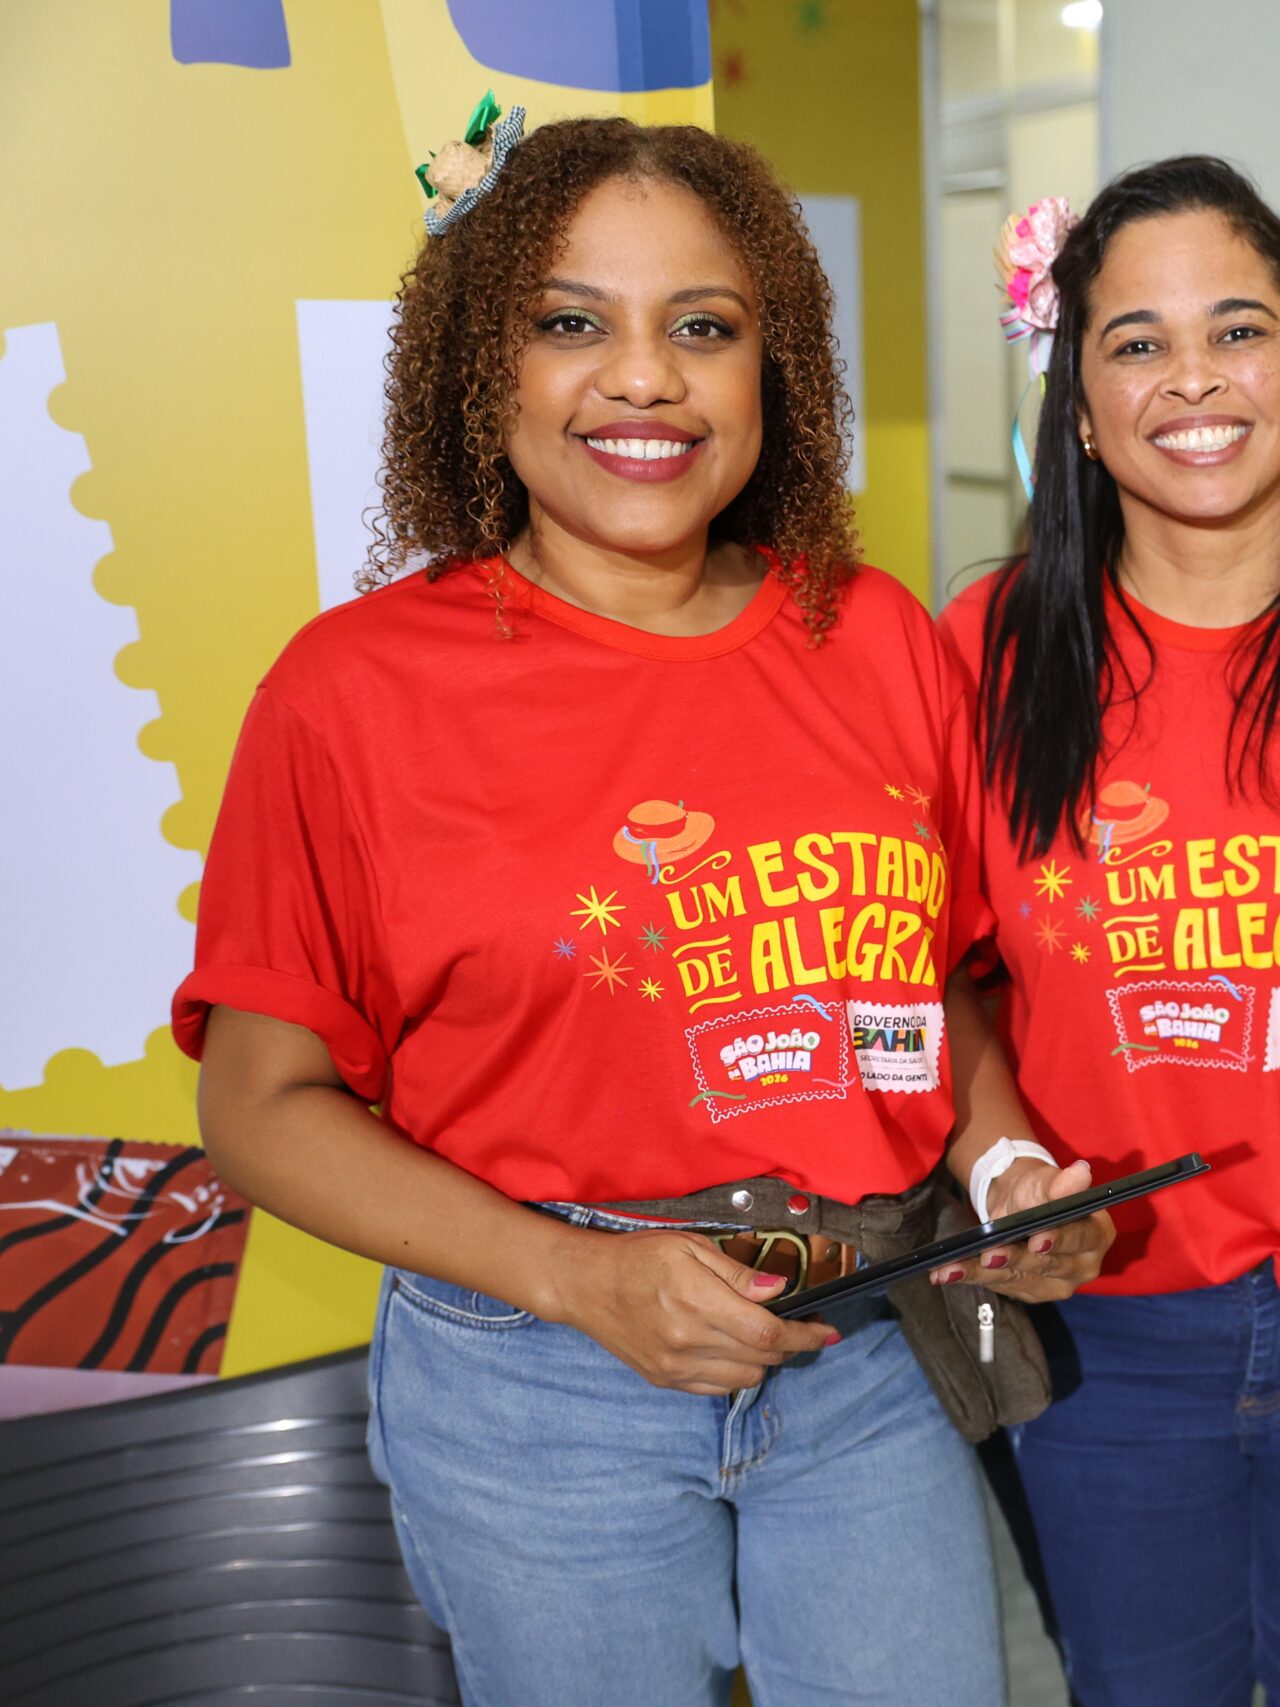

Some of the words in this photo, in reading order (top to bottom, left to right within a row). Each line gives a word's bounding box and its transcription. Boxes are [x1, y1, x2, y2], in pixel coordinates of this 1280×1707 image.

[666, 875, 747, 930] UM
[747, 831, 946, 919] ESTADO
[1104, 863, 1177, 906] UM
[1105, 924, 1164, 965] DE
[676, 947, 739, 998] DE
[854, 1014, 915, 1029] GOVERNO
[916, 1015, 927, 1027] DA
[1155, 1018, 1222, 1043] BAHIA
[738, 1050, 812, 1082] BAHIA
[760, 1073, 789, 1087] 2026
[866, 1071, 890, 1081] LADO
[892, 1073, 904, 1081] DA
